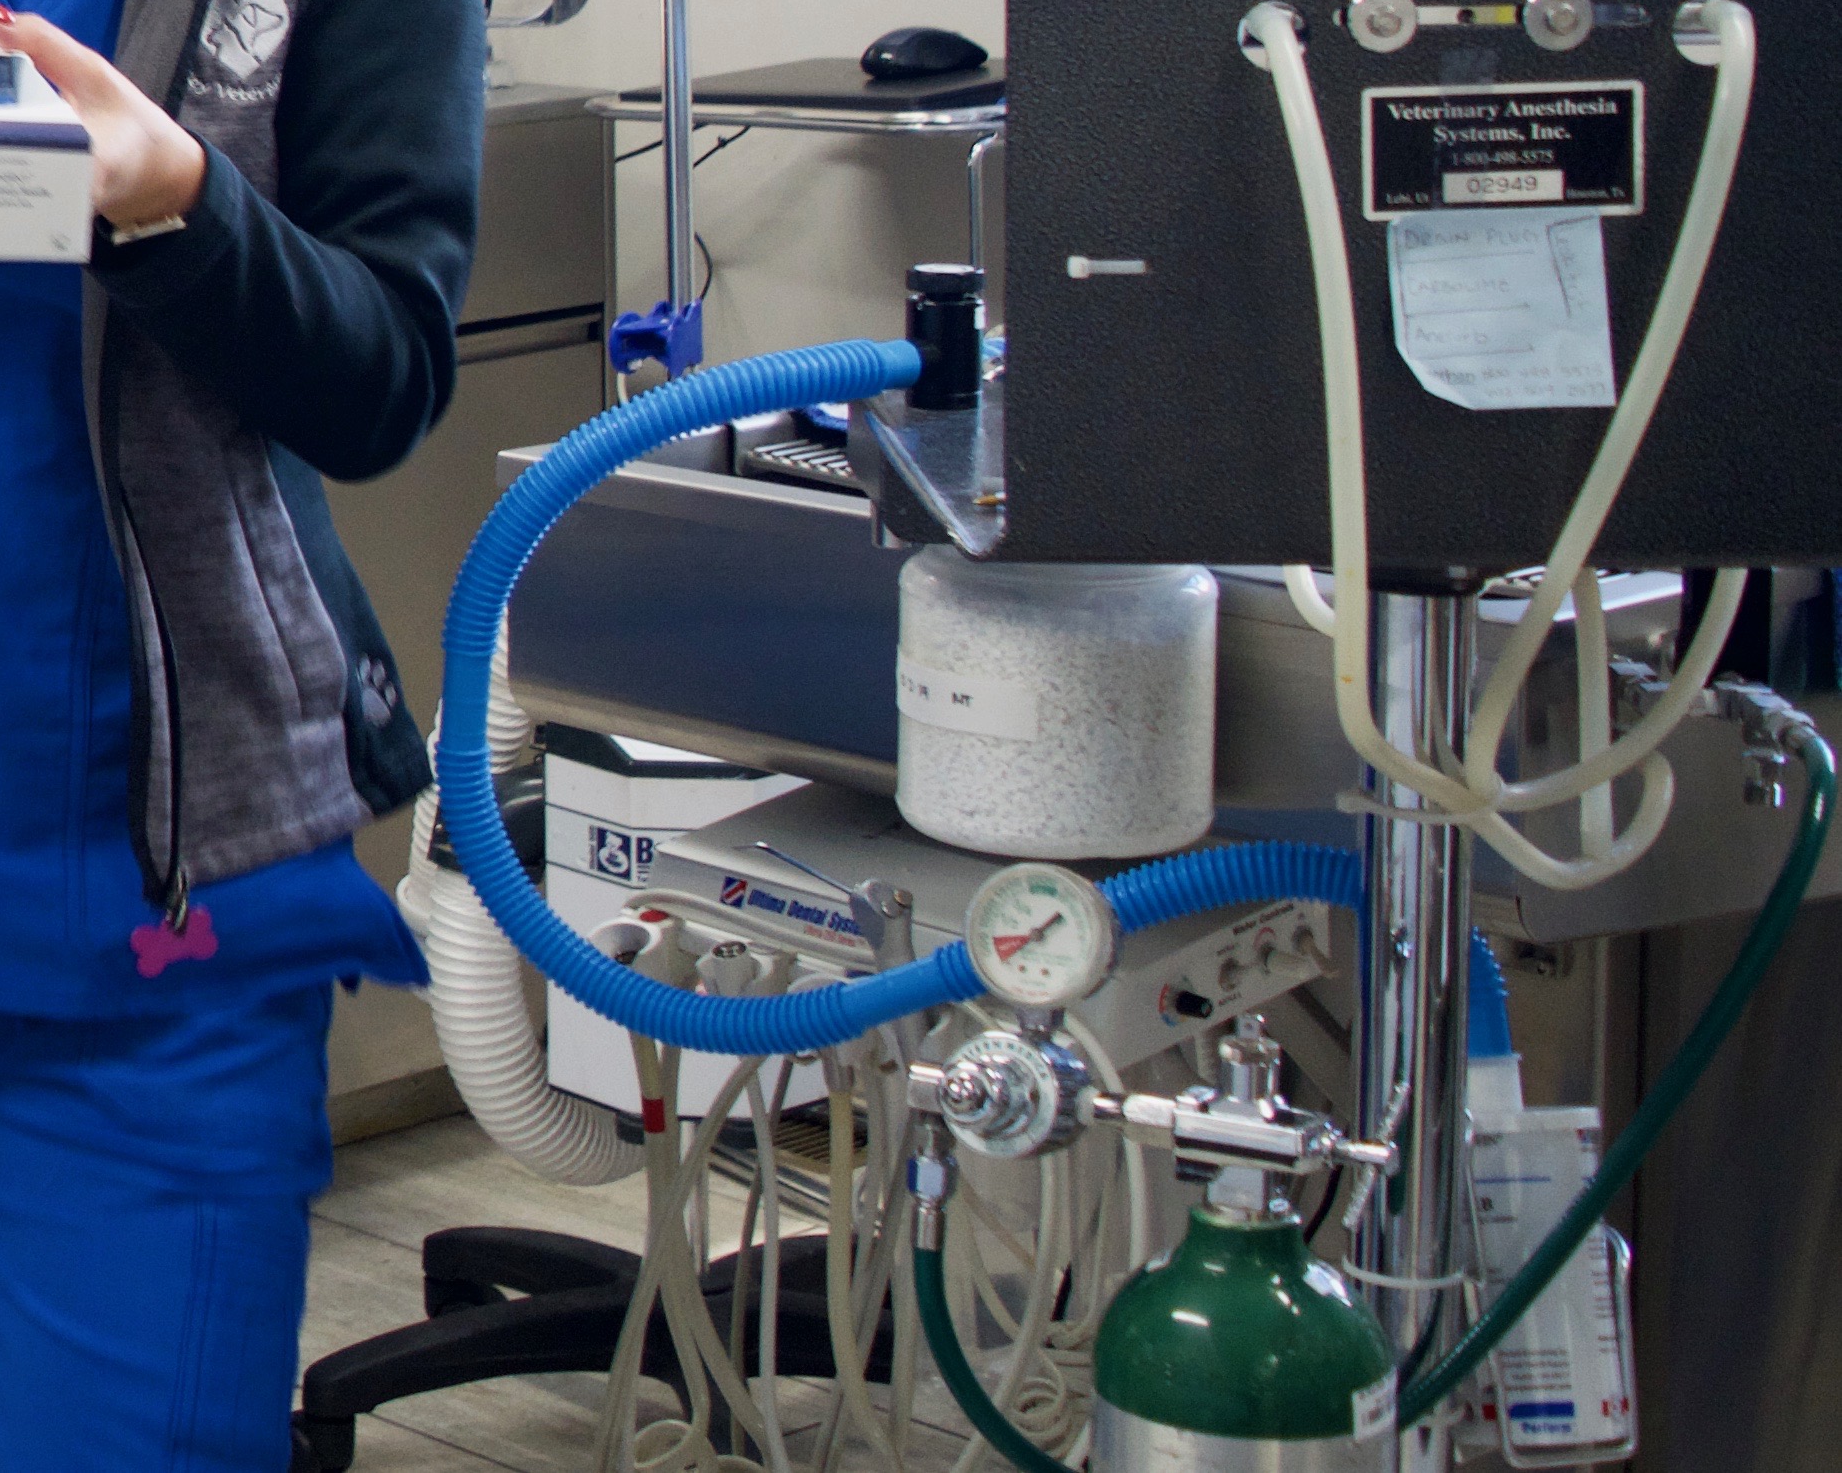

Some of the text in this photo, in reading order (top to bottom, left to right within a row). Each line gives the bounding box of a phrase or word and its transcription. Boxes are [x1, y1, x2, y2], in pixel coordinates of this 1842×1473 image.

[1386, 97, 1618, 122] Veterinary Anesthesia
[1433, 123, 1572, 146] Systems, Inc.
[1466, 175, 1538, 194] 02949
